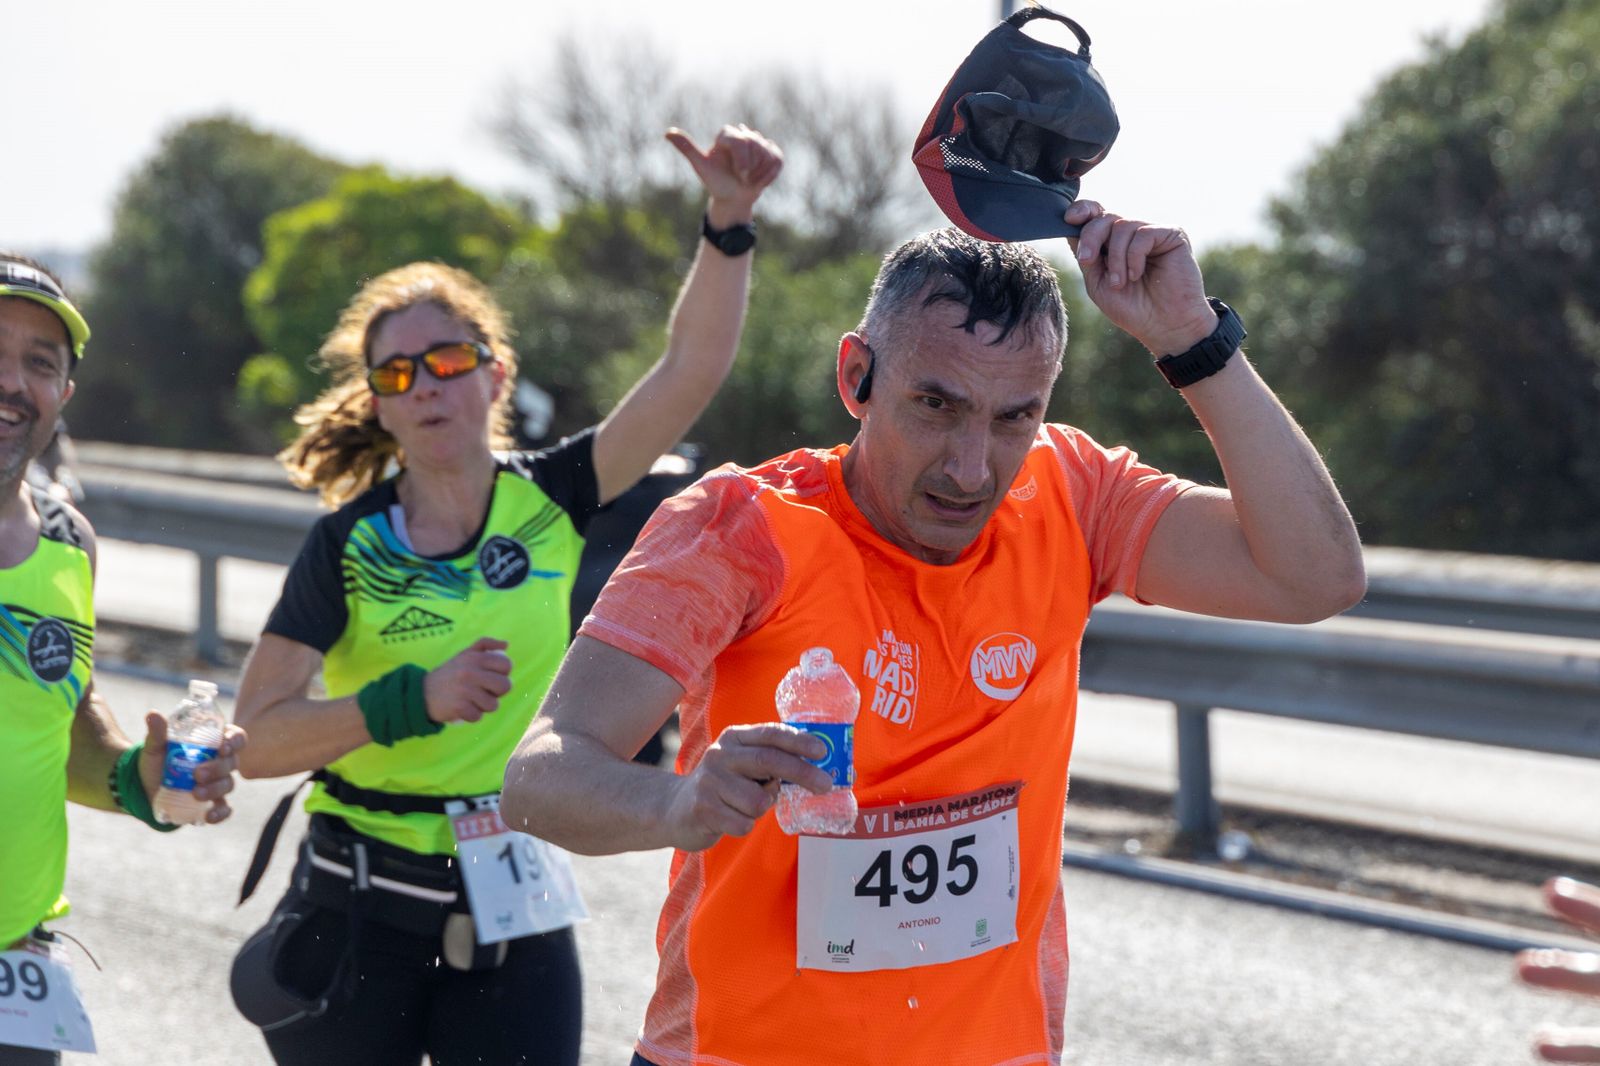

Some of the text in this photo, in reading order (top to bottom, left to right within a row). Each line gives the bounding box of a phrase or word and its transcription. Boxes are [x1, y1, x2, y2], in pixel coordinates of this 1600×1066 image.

[893, 794, 1016, 832] BAHÍA DE CÁDIZ
[894, 804, 945, 821] MEDIA
[854, 834, 979, 908] 495
[897, 916, 942, 929] ANTONIO
[827, 938, 855, 956] imd
